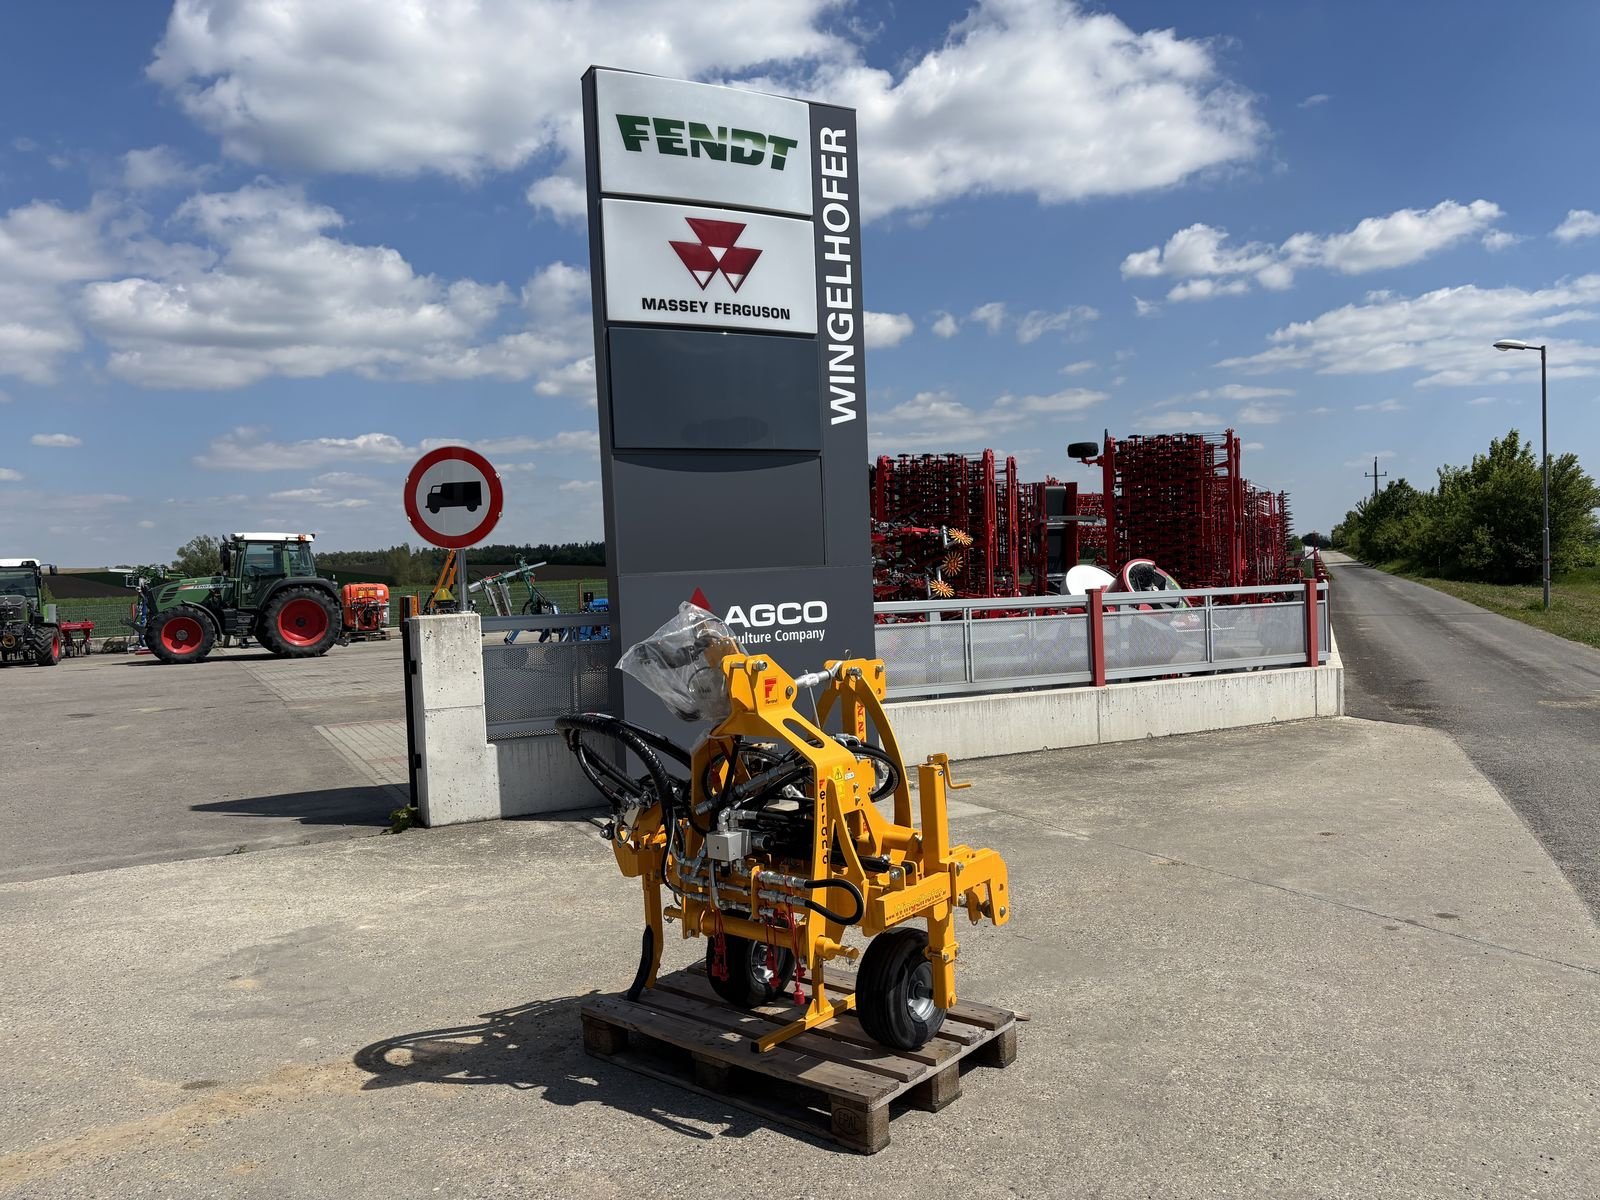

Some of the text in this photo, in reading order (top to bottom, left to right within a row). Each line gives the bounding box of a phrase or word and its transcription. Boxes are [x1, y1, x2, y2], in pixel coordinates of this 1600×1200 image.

[615, 113, 799, 171] FENDT
[819, 125, 858, 426] WINGELHOFER
[641, 297, 791, 320] MASSEY FERGUSON
[724, 600, 828, 628] AGCO
[735, 629, 825, 645] ulture Company
